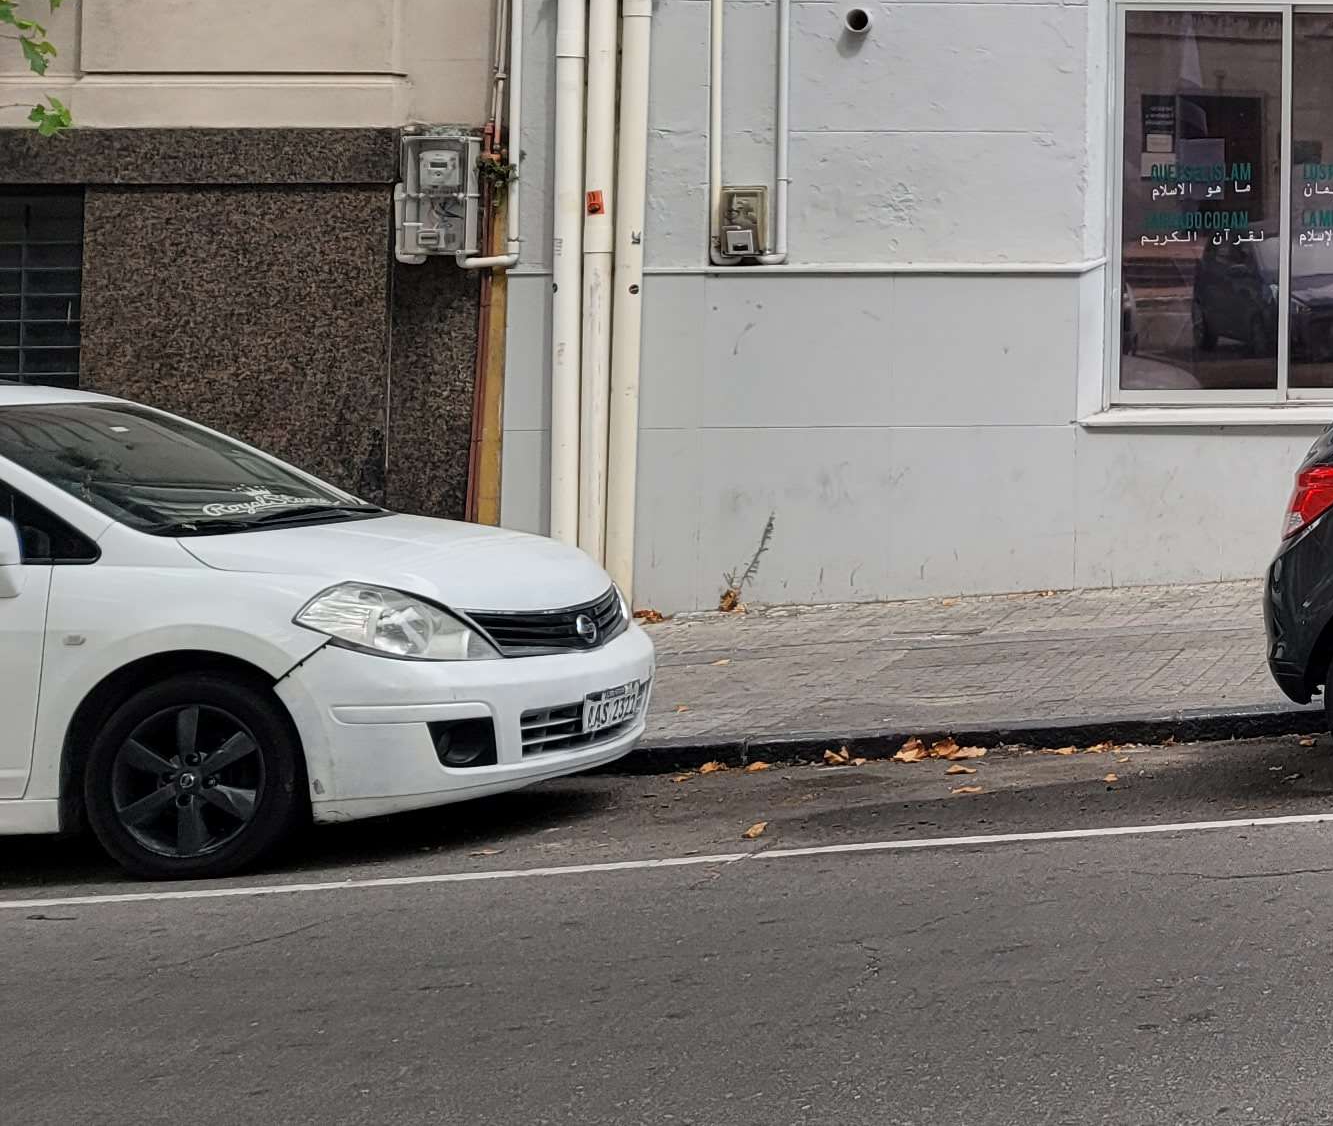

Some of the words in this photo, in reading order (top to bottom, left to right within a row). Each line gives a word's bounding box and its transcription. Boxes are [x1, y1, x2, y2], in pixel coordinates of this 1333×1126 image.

[1152, 162, 1175, 180] QUE
[1152, 182, 1192, 200] الاسلام
[1205, 184, 1221, 197] هو
[1234, 181, 1251, 193] ما
[1203, 211, 1249, 229] CORAN
[1141, 230, 1198, 246] الكريم
[203, 495, 263, 515] Royal
